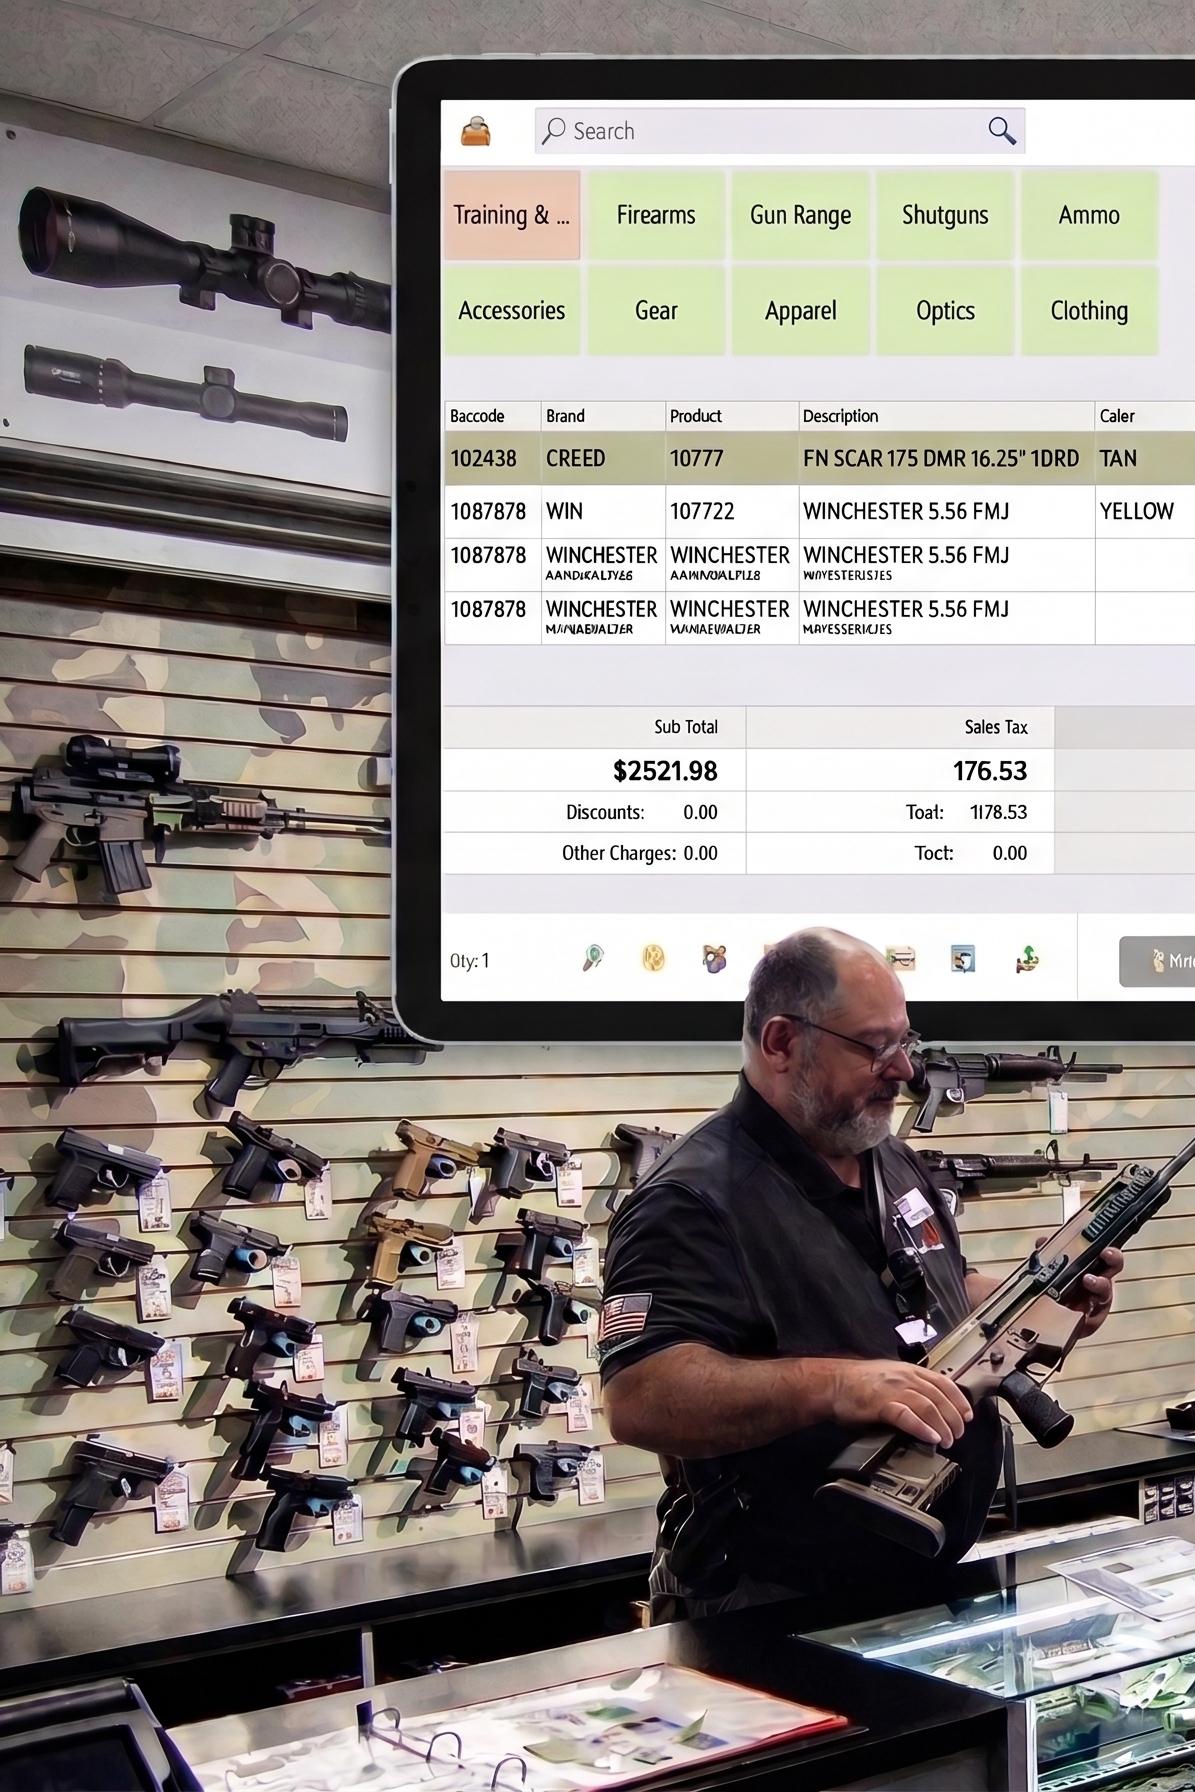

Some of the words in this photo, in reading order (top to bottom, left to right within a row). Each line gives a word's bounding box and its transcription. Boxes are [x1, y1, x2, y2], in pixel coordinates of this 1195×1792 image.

[574, 119, 635, 141] Search
[453, 203, 528, 231] Training
[534, 204, 550, 225] &
[617, 204, 696, 225] Firearms
[750, 203, 787, 225] Gun
[794, 204, 852, 231] Range
[902, 203, 989, 231] Shutguns
[1058, 204, 1120, 225] Ammo
[458, 299, 566, 320] Accessories
[635, 299, 679, 321] Gear
[764, 299, 837, 326] Apparel
[916, 299, 976, 326] Optics
[1051, 299, 1128, 326] Clothing
[450, 407, 505, 423] Baccode
[546, 407, 585, 423] Brand
[670, 407, 723, 423] Product
[803, 407, 879, 427] Description
[1100, 408, 1136, 423] Caler
[450, 449, 517, 468] 102438
[546, 448, 606, 468] CREED
[670, 449, 724, 468] 10777
[804, 448, 829, 467] FN
[833, 448, 883, 468] SCAR
[887, 448, 919, 468] 175
[923, 448, 966, 468] DMR
[970, 449, 1026, 468] 16.25"
[1030, 448, 1080, 468] 1DRD
[1098, 448, 1137, 468] TAN
[451, 501, 526, 521] 1087878
[545, 501, 583, 520] WIN
[670, 501, 735, 520] 107722
[802, 501, 924, 521] WINCHESTER
[928, 501, 968, 521] 5.56
[973, 501, 1009, 521] FMJ
[1099, 501, 1175, 521] YELLOW
[450, 545, 527, 564] 1087878
[545, 545, 658, 564] WINCHESTER
[670, 545, 791, 564] WINCHESTER
[803, 545, 924, 564] WINCHESTER
[928, 545, 968, 564] 5.56
[973, 545, 1009, 564] FMJ
[451, 599, 526, 618] 1087878
[545, 599, 658, 618] WINCHESTER
[669, 599, 790, 618] WINCHESTER
[803, 599, 924, 618] WINCHESTER
[928, 599, 968, 618] 5.56
[973, 599, 1009, 618] FMJ
[654, 719, 681, 735] Sub
[685, 719, 718, 735] Total
[965, 718, 1001, 735] Sales
[1004, 719, 1029, 735] Tax
[613, 758, 718, 783] $2521.98
[953, 760, 1028, 782] 176.53
[567, 803, 645, 820] Discounts:
[683, 804, 718, 820] 0.00
[562, 844, 606, 861] Other
[609, 844, 677, 866] Charges:
[683, 845, 718, 861] 0.00
[913, 844, 954, 861] Toct:
[992, 845, 1028, 861] 0.00
[481, 952, 488, 969] 1
